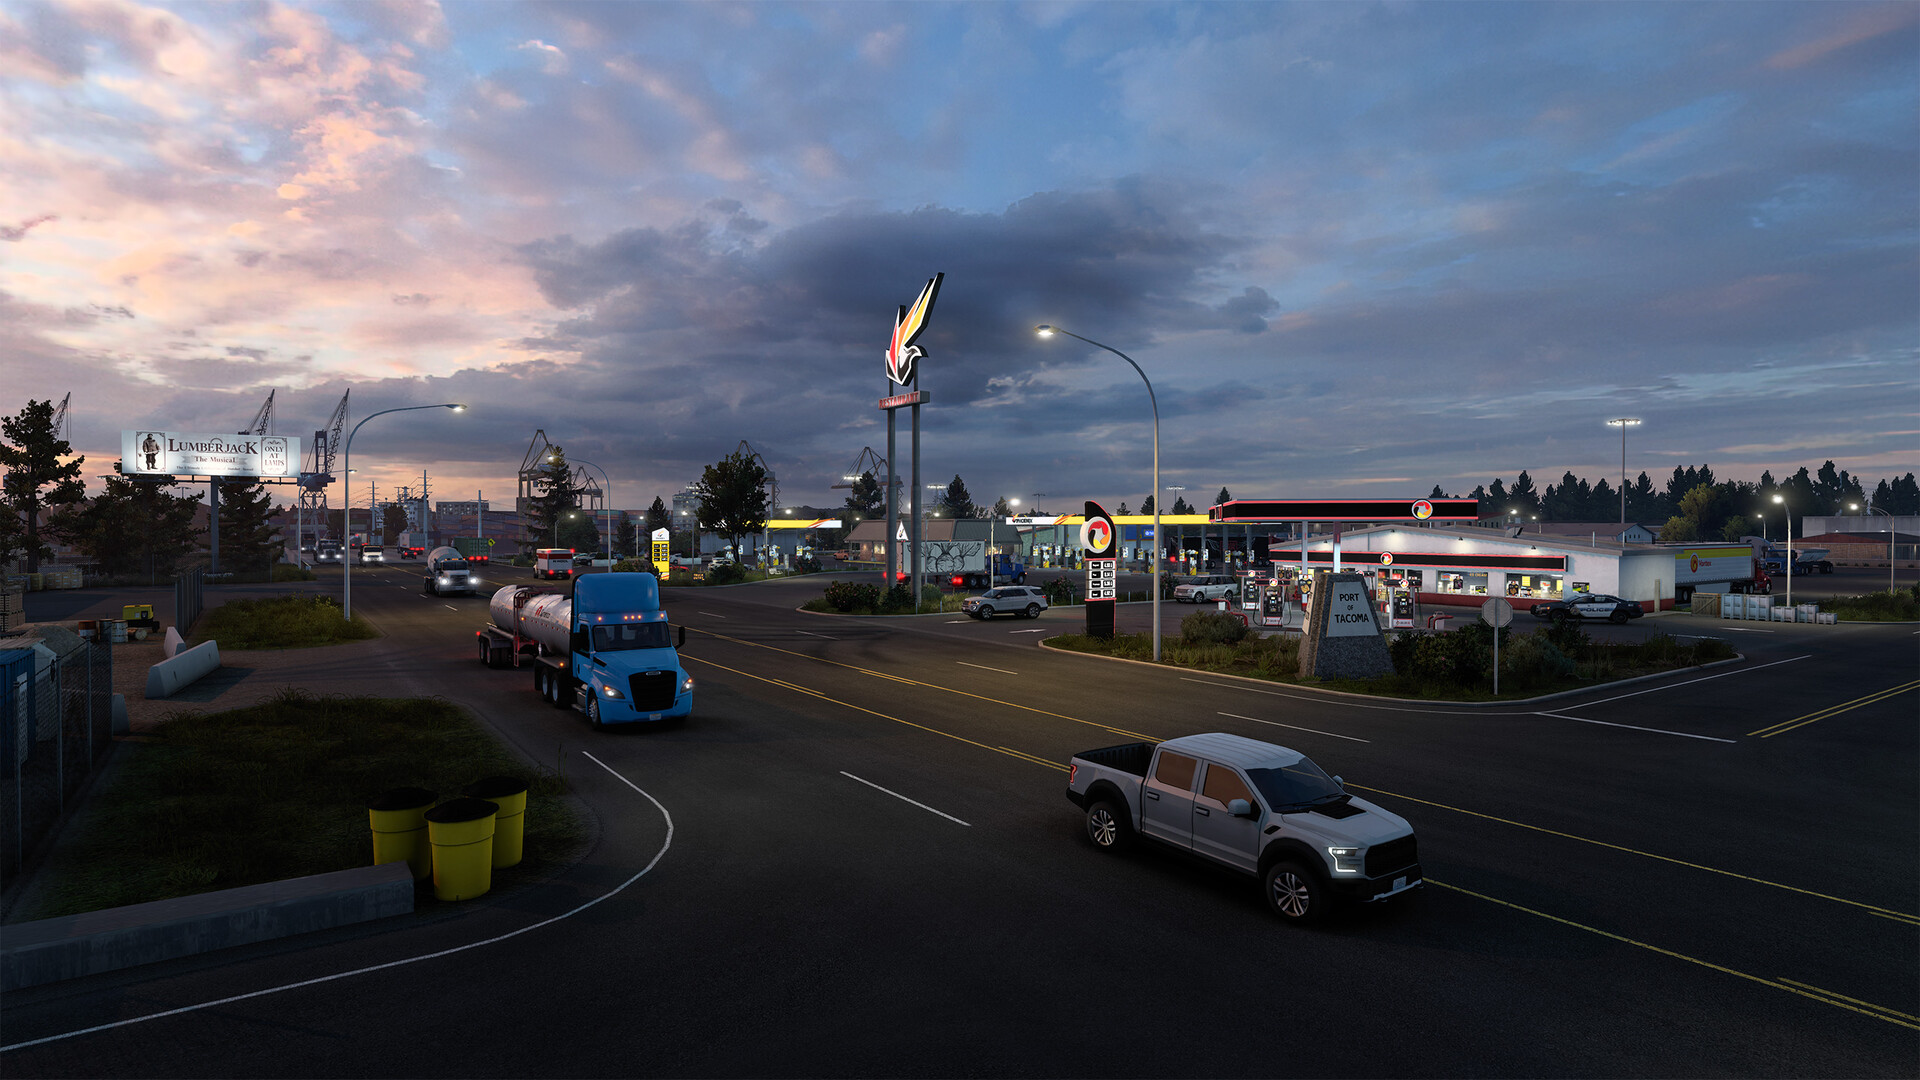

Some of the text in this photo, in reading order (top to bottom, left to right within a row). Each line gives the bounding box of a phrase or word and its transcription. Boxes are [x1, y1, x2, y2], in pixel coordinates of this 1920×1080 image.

[879, 392, 918, 409] RESTAURANT
[210, 456, 236, 464] Musical
[264, 459, 285, 467] LAMPS
[1339, 593, 1360, 602] PORT
[1334, 613, 1370, 623] TACOMA
